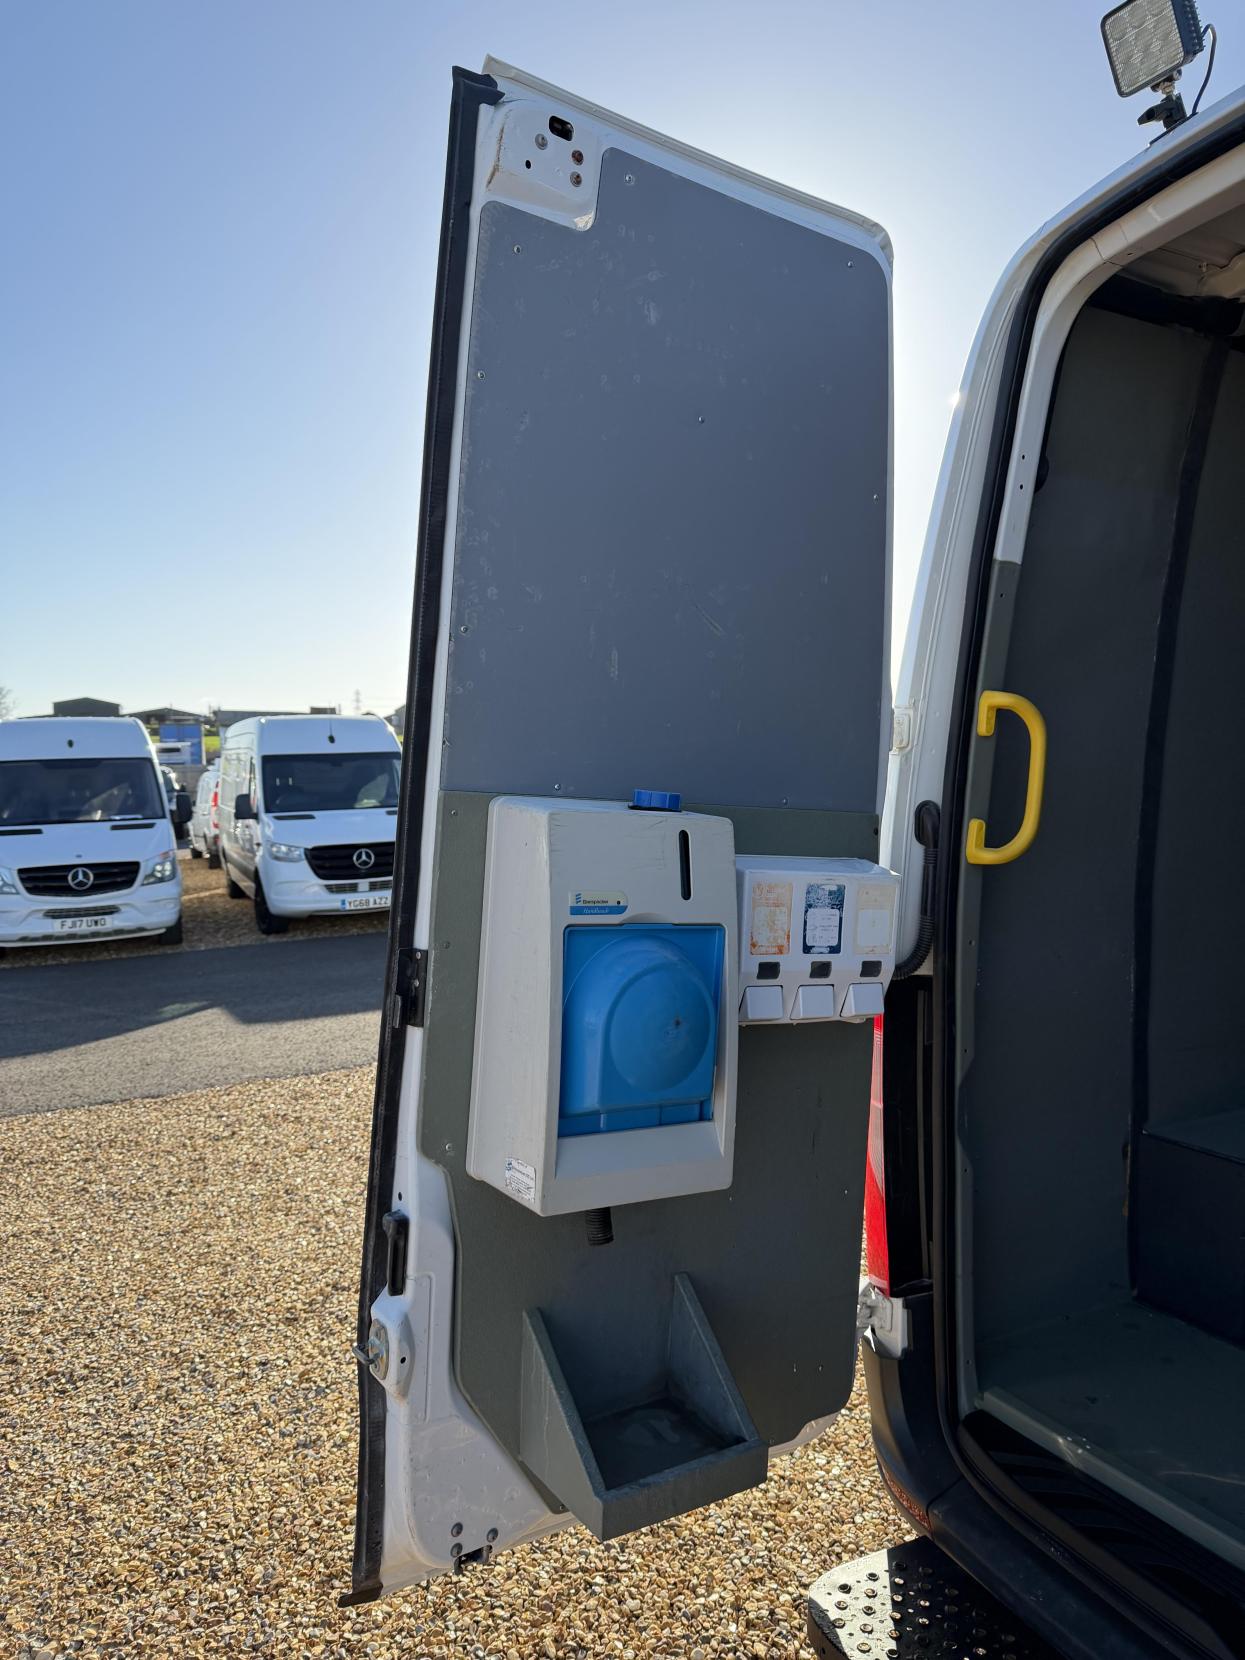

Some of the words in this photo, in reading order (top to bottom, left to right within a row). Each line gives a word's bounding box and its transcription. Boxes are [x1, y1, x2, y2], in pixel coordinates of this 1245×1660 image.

[347, 898, 370, 909] YG68
[372, 896, 389, 906] AZZ
[60, 919, 84, 930] FJ17
